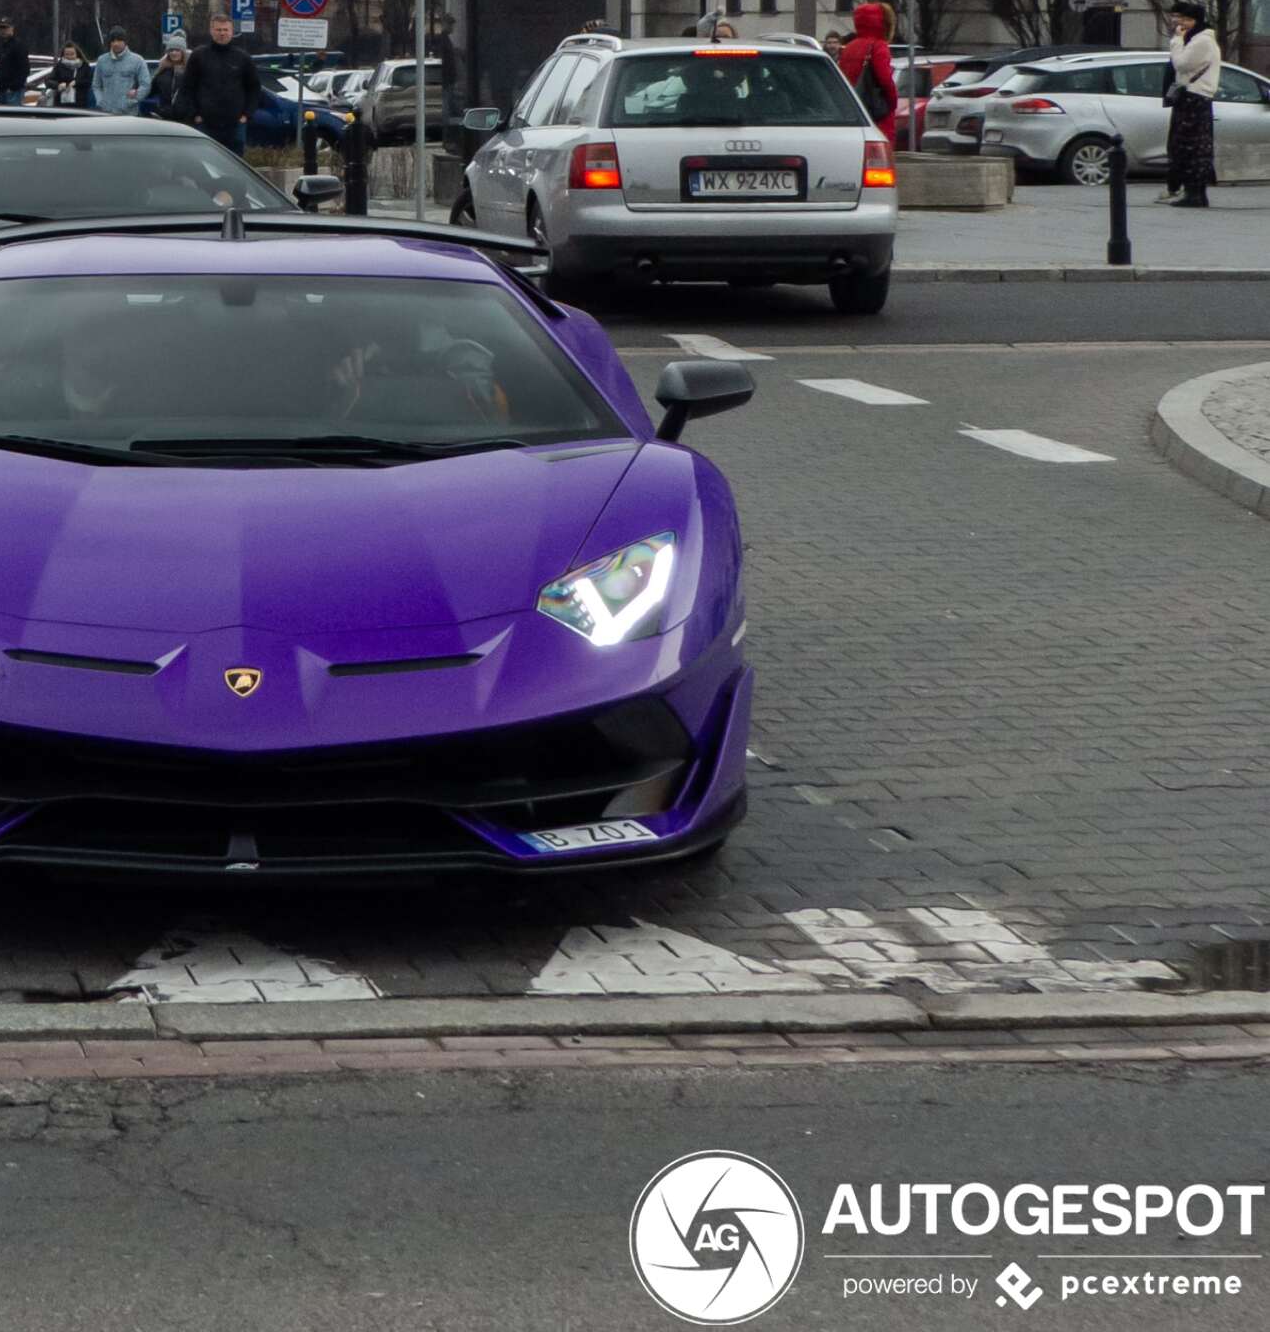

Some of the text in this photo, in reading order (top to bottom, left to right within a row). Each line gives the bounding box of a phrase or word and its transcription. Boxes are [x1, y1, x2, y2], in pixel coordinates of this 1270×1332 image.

[167, 17, 179, 32] P
[703, 172, 793, 190] WX 924XC
[537, 832, 569, 847] B
